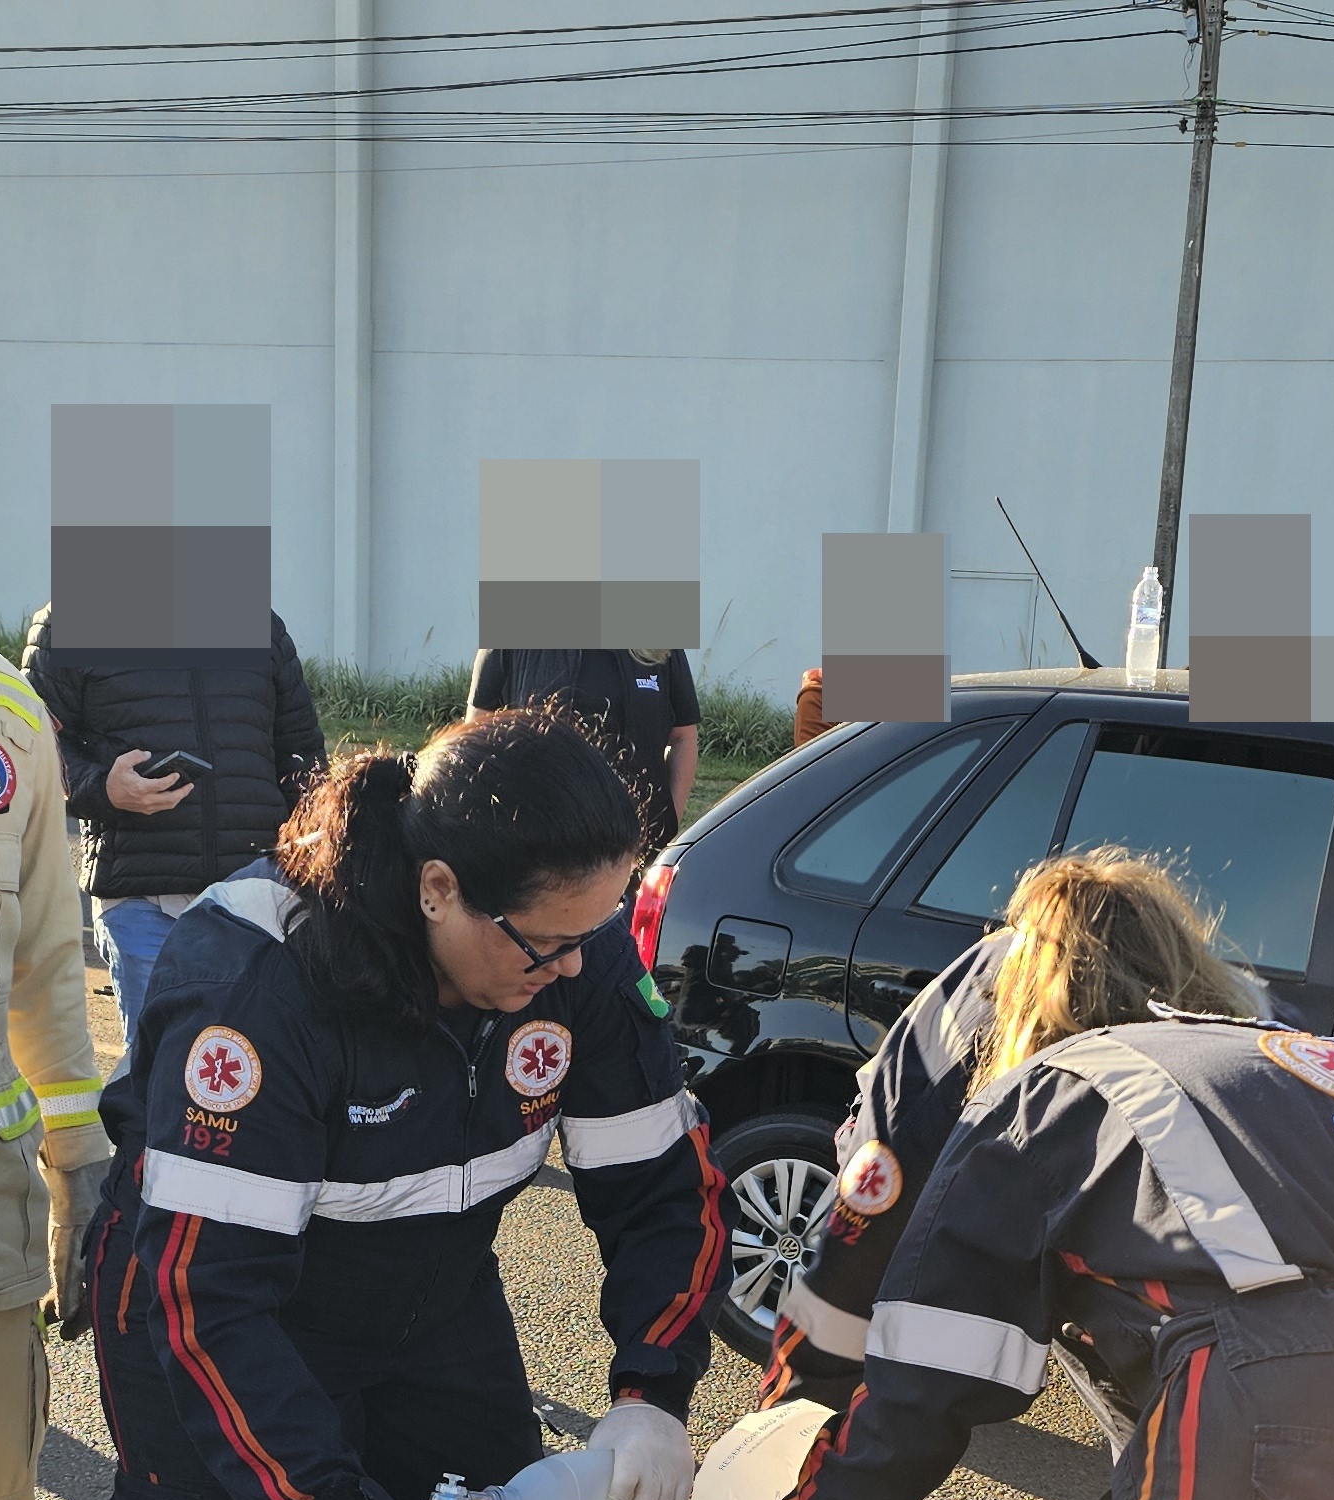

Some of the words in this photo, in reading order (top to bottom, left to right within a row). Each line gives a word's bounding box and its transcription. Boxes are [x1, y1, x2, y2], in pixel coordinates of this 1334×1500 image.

[519, 1090, 561, 1115] SAMU
[185, 1106, 238, 1133] SAMU
[183, 1123, 234, 1157] 192
